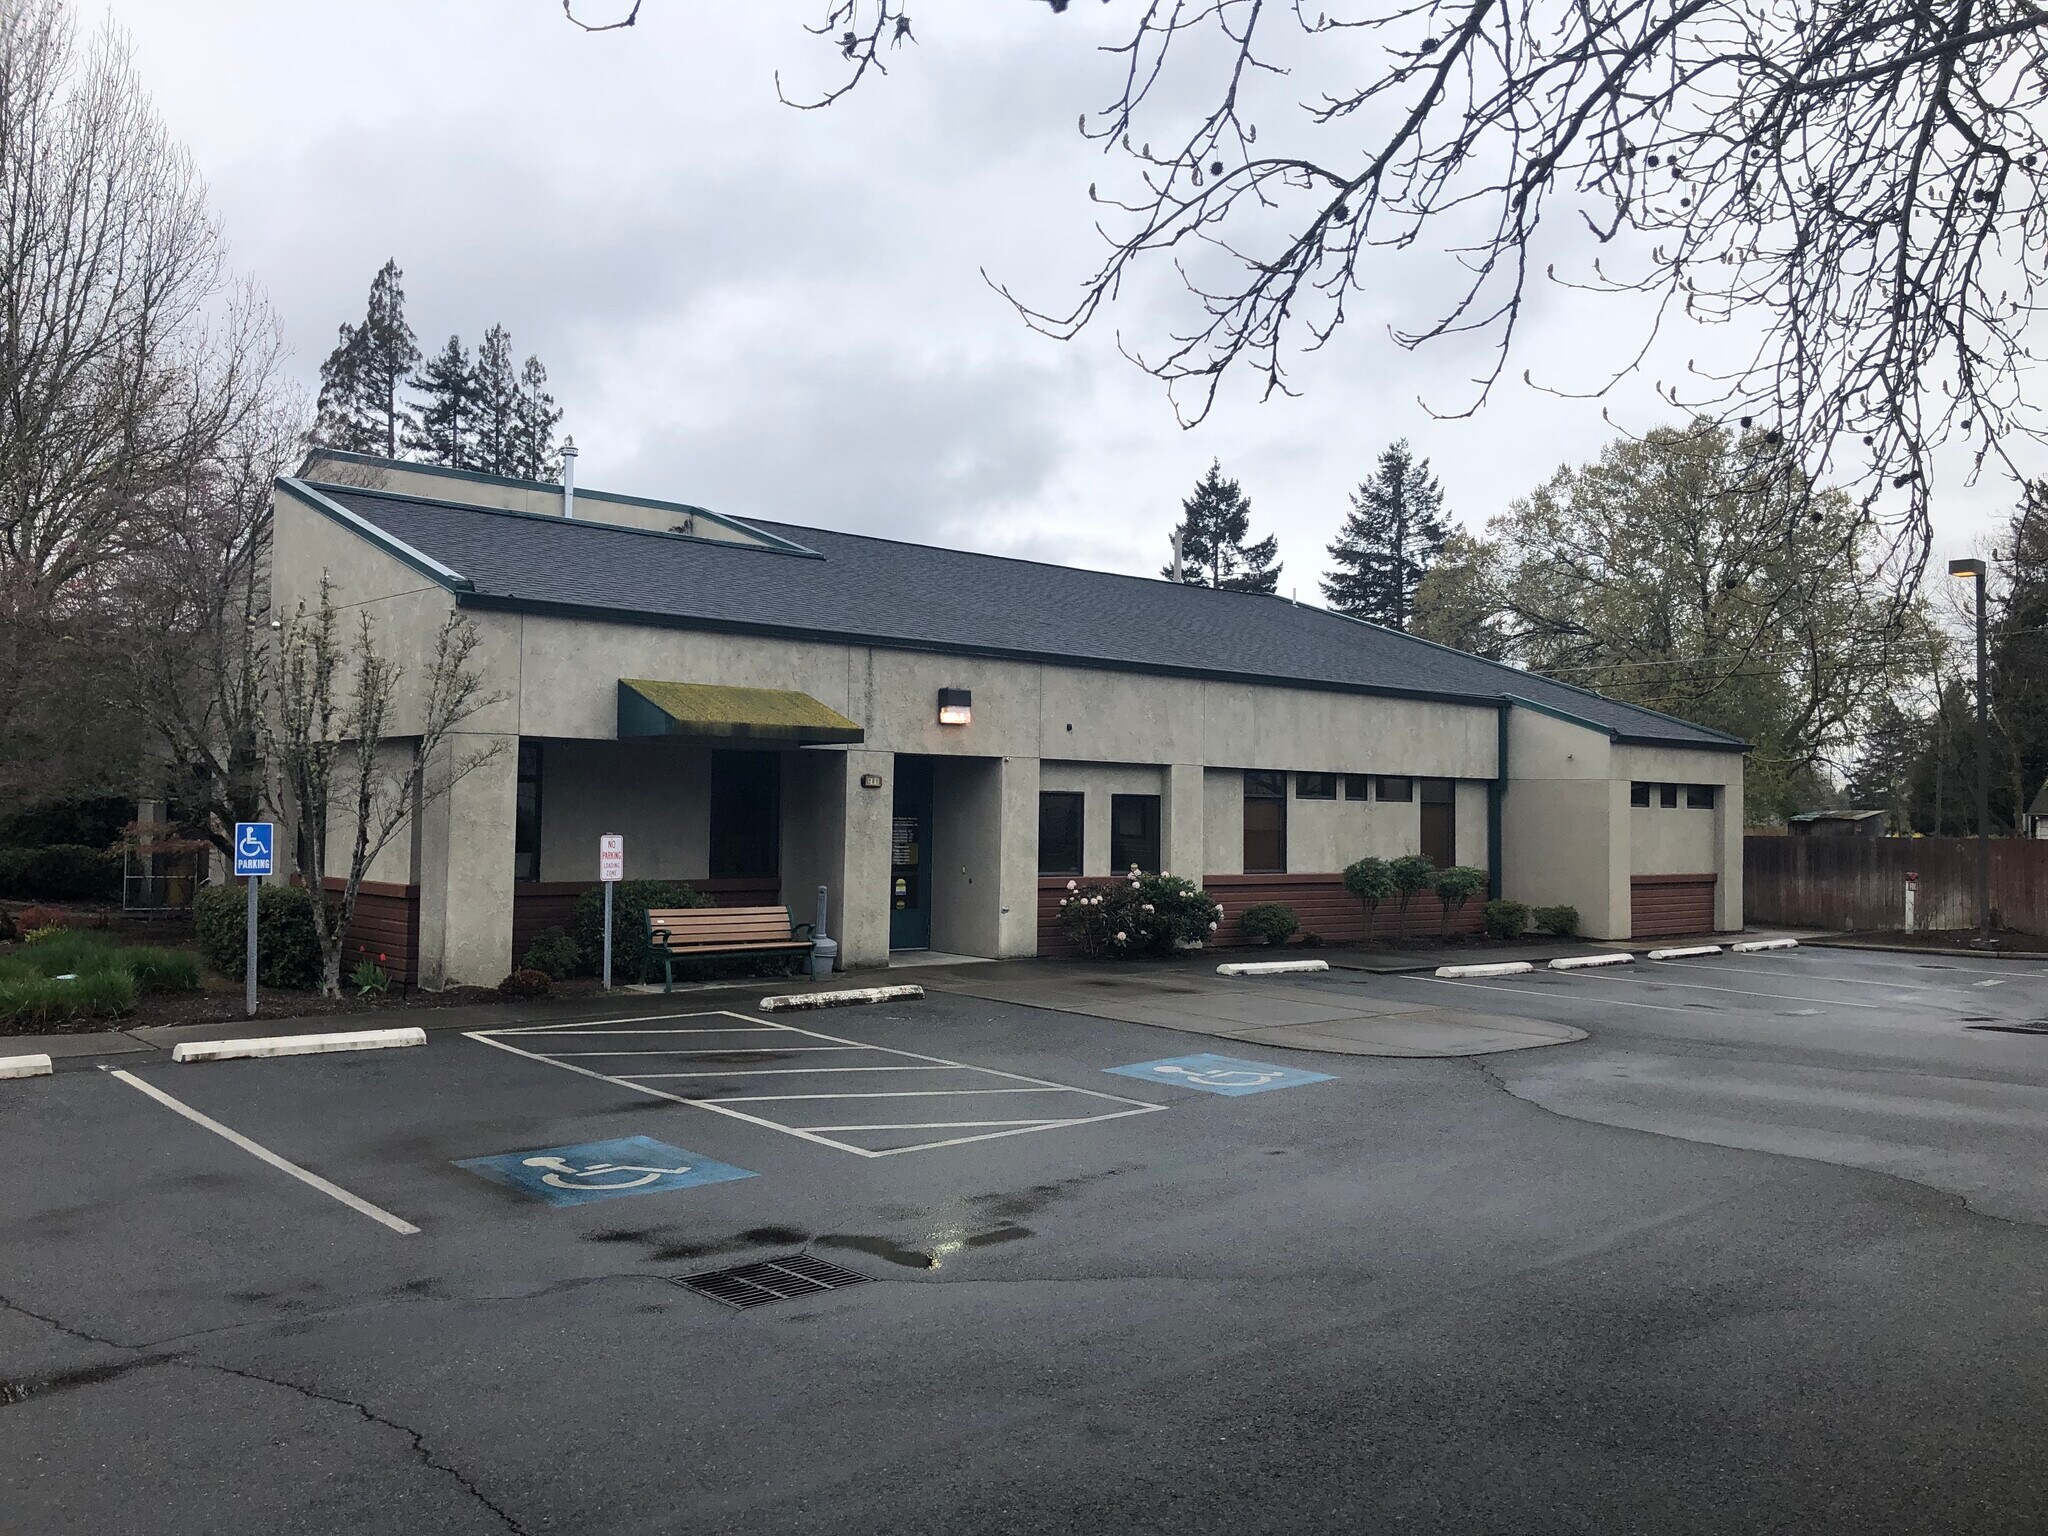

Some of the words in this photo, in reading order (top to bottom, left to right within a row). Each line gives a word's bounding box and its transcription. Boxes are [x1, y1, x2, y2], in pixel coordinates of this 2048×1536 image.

[608, 840, 616, 849] NO
[602, 851, 621, 860] PARKING
[238, 859, 270, 869] PARKING
